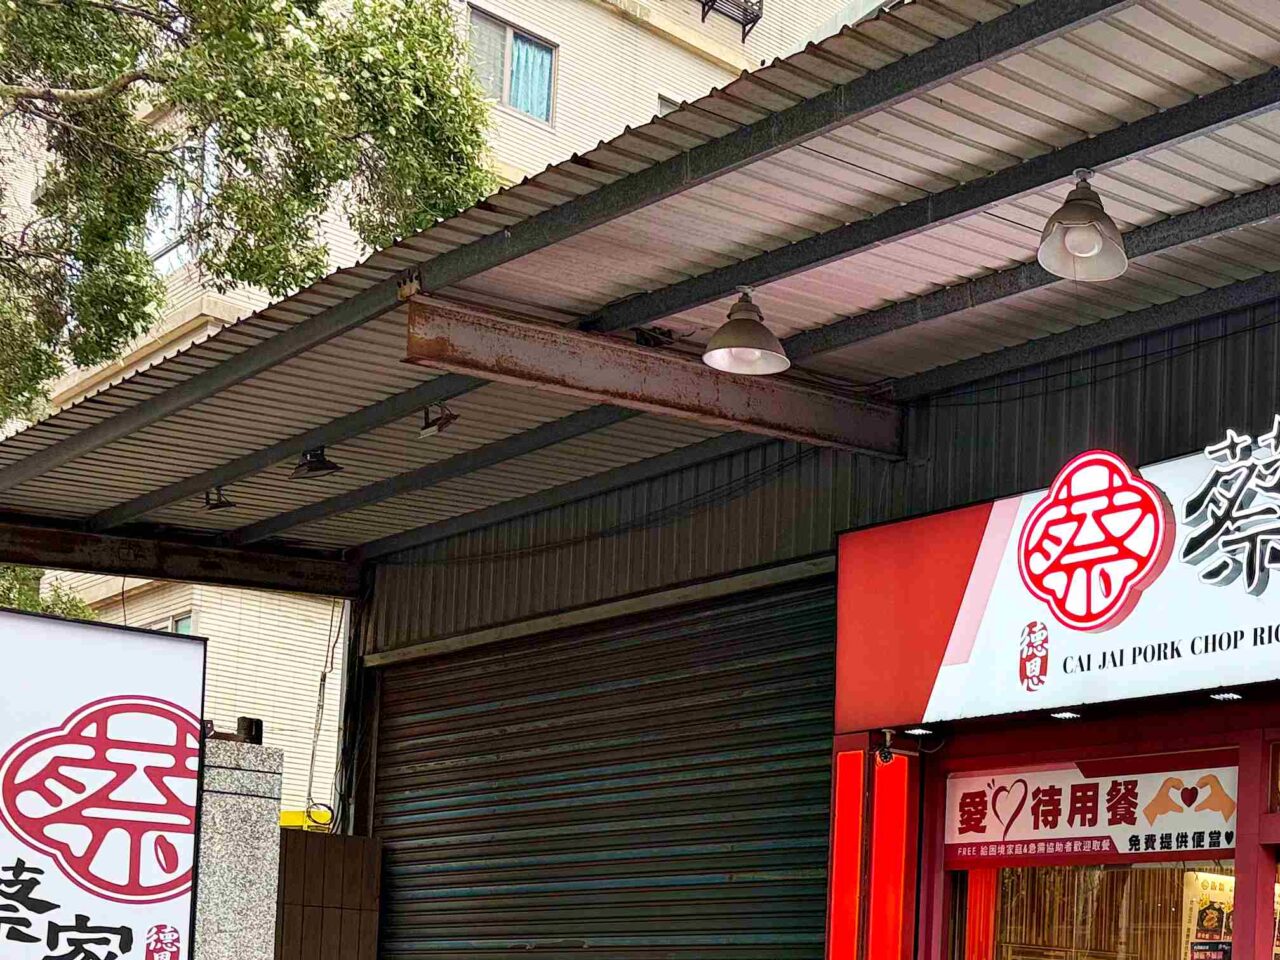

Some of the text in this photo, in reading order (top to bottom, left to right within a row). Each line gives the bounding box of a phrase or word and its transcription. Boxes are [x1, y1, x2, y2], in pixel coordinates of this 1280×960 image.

[1062, 653, 1091, 675] CAI
[1098, 649, 1124, 670] JAI
[1131, 640, 1183, 665] PORK
[1190, 629, 1244, 655] CHOP
